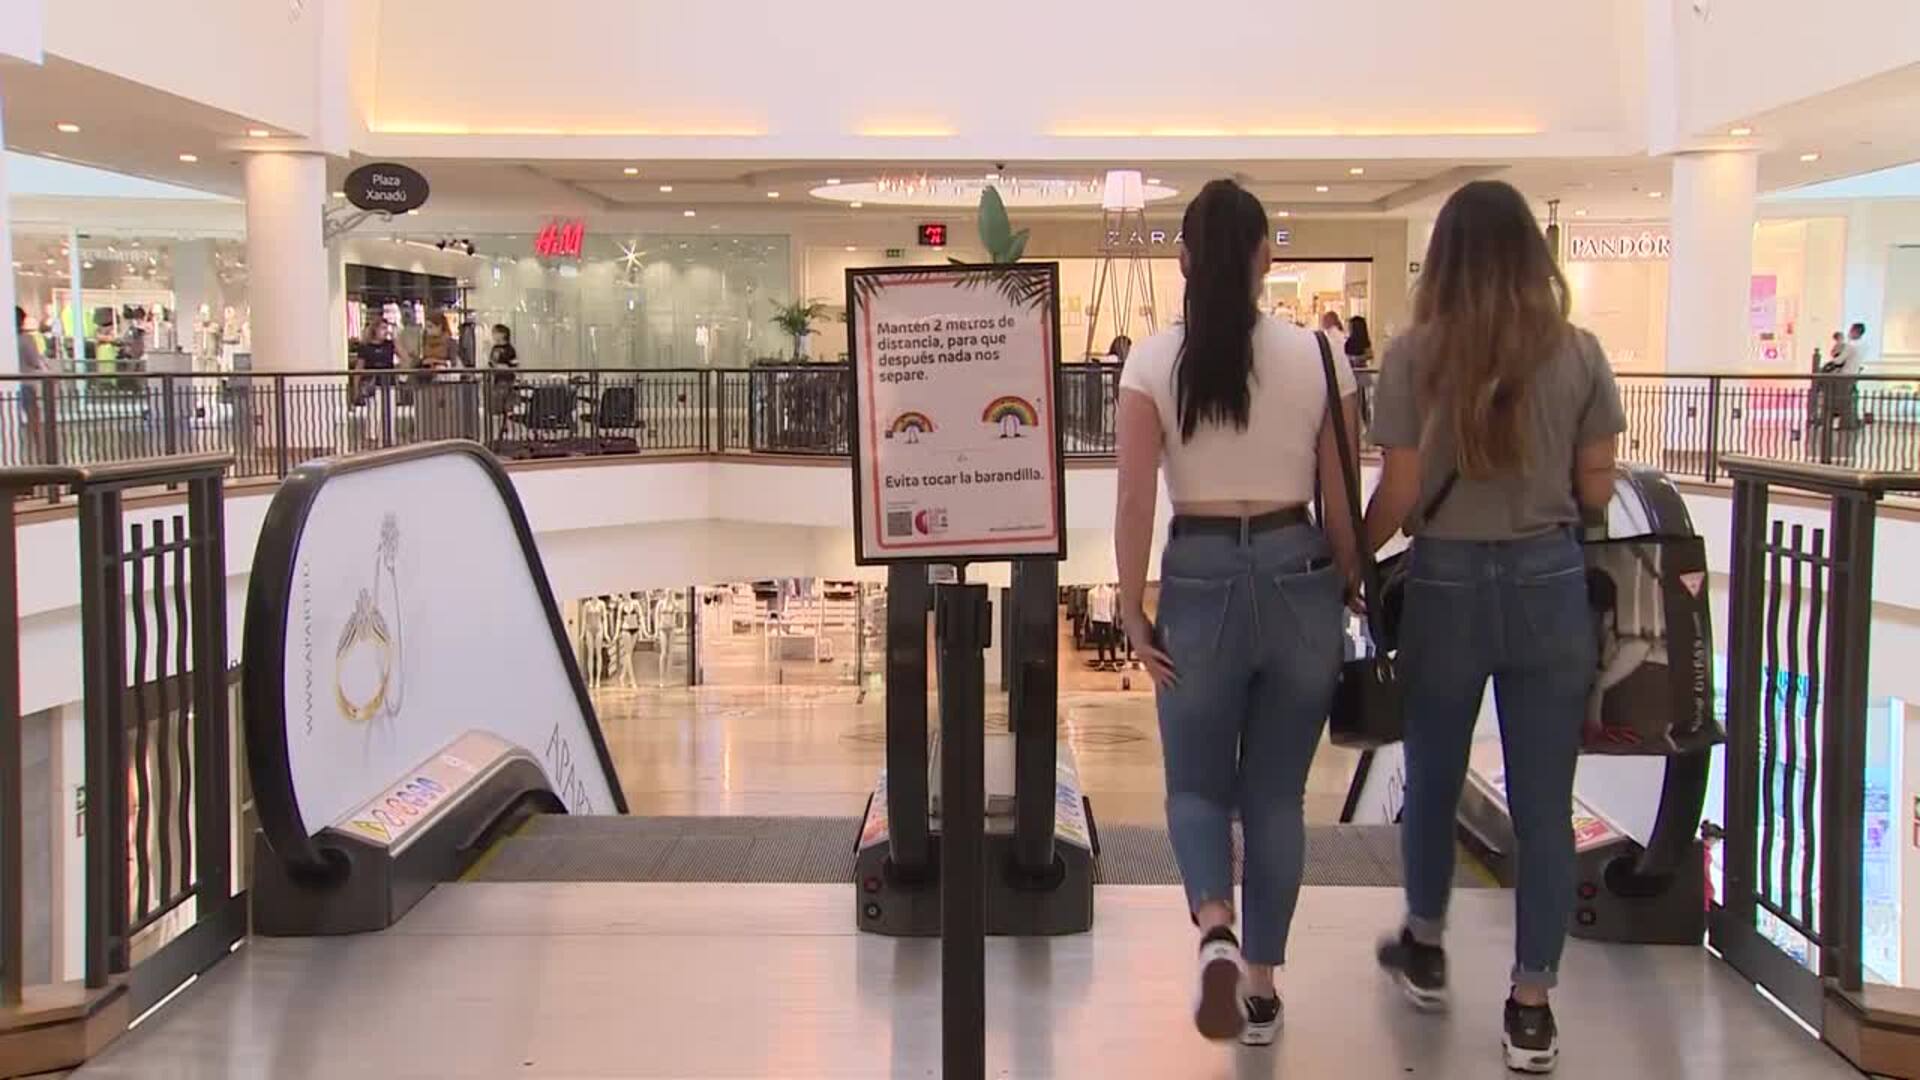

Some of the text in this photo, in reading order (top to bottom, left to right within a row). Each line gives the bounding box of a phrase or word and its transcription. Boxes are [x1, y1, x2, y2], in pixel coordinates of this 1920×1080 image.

[372, 173, 401, 186] Plaza
[366, 189, 407, 202] Xanadú
[535, 223, 584, 257] H&M
[933, 319, 942, 332] 2
[946, 318, 995, 332] metros
[998, 315, 1015, 328] de
[877, 332, 1007, 351] distancia, para que
[878, 350, 1000, 368] después nada nos
[879, 369, 929, 384] separe.
[885, 467, 1045, 489] Evita tocar la barandilla.
